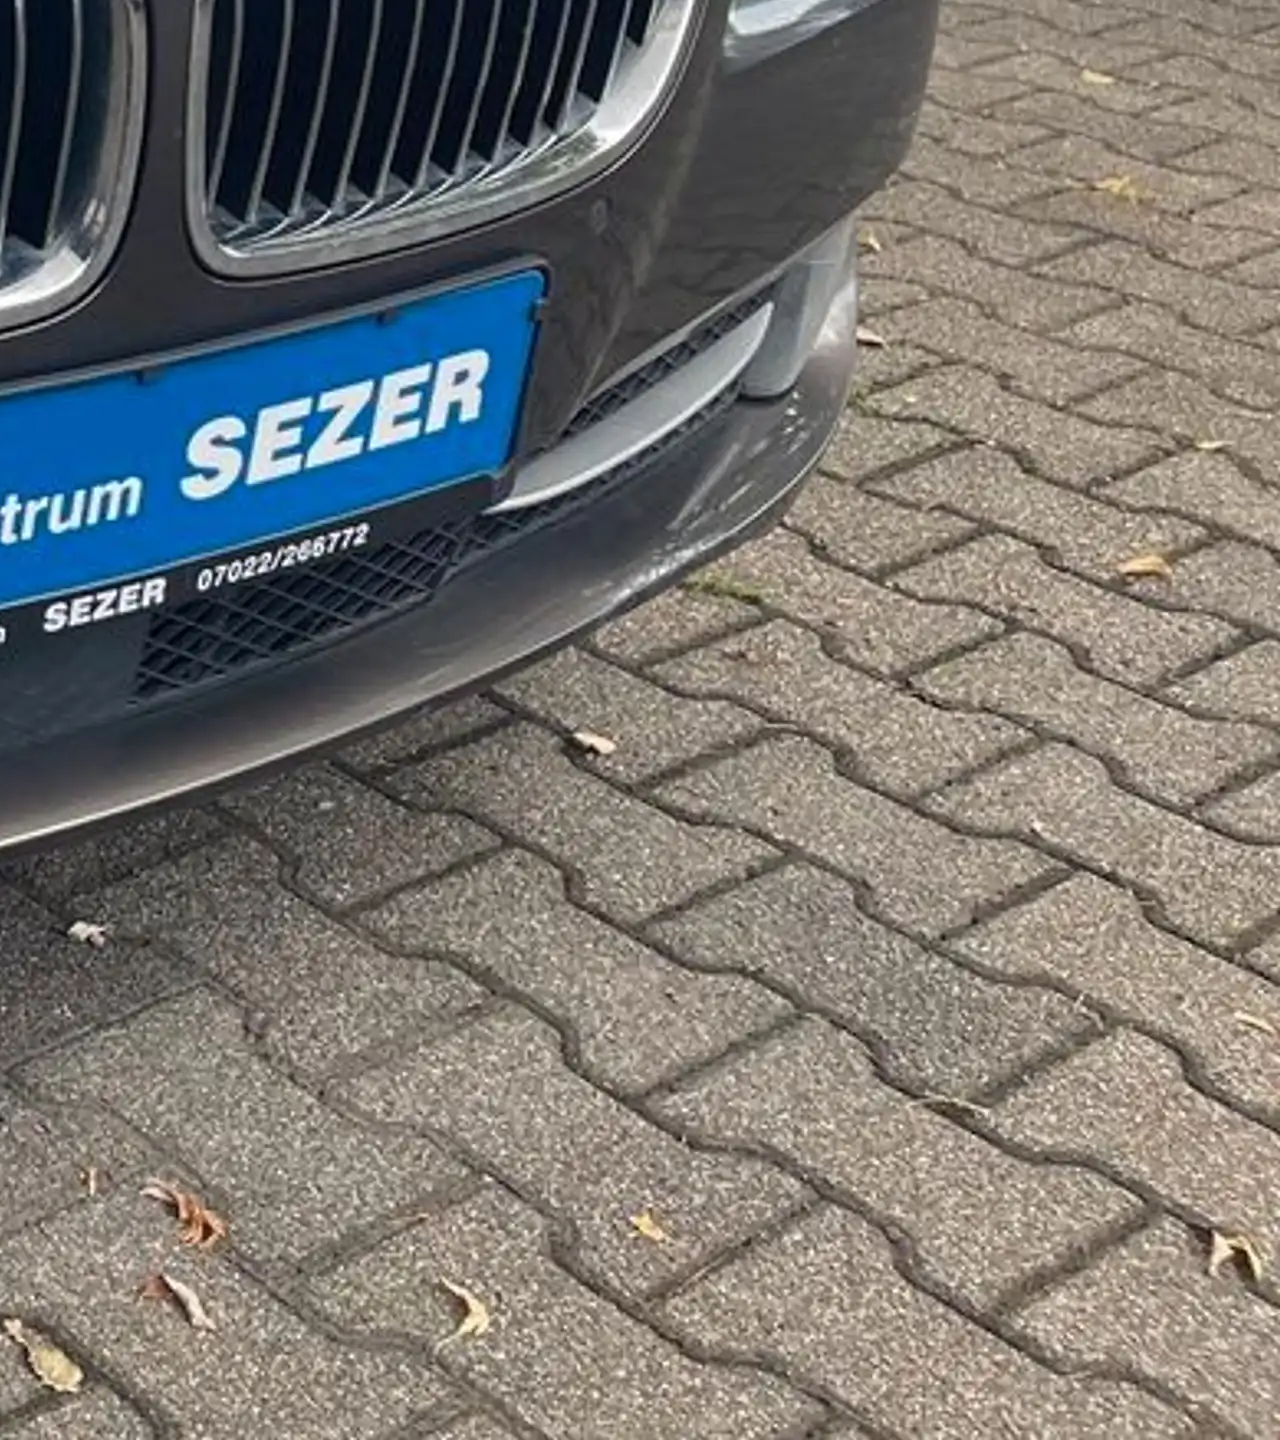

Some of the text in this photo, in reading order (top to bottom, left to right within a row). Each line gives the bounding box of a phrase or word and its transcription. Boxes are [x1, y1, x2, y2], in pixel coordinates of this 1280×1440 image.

[180, 349, 489, 500] SEZER
[42, 576, 168, 633] SEZER
[196, 522, 371, 593] 07022/266772
